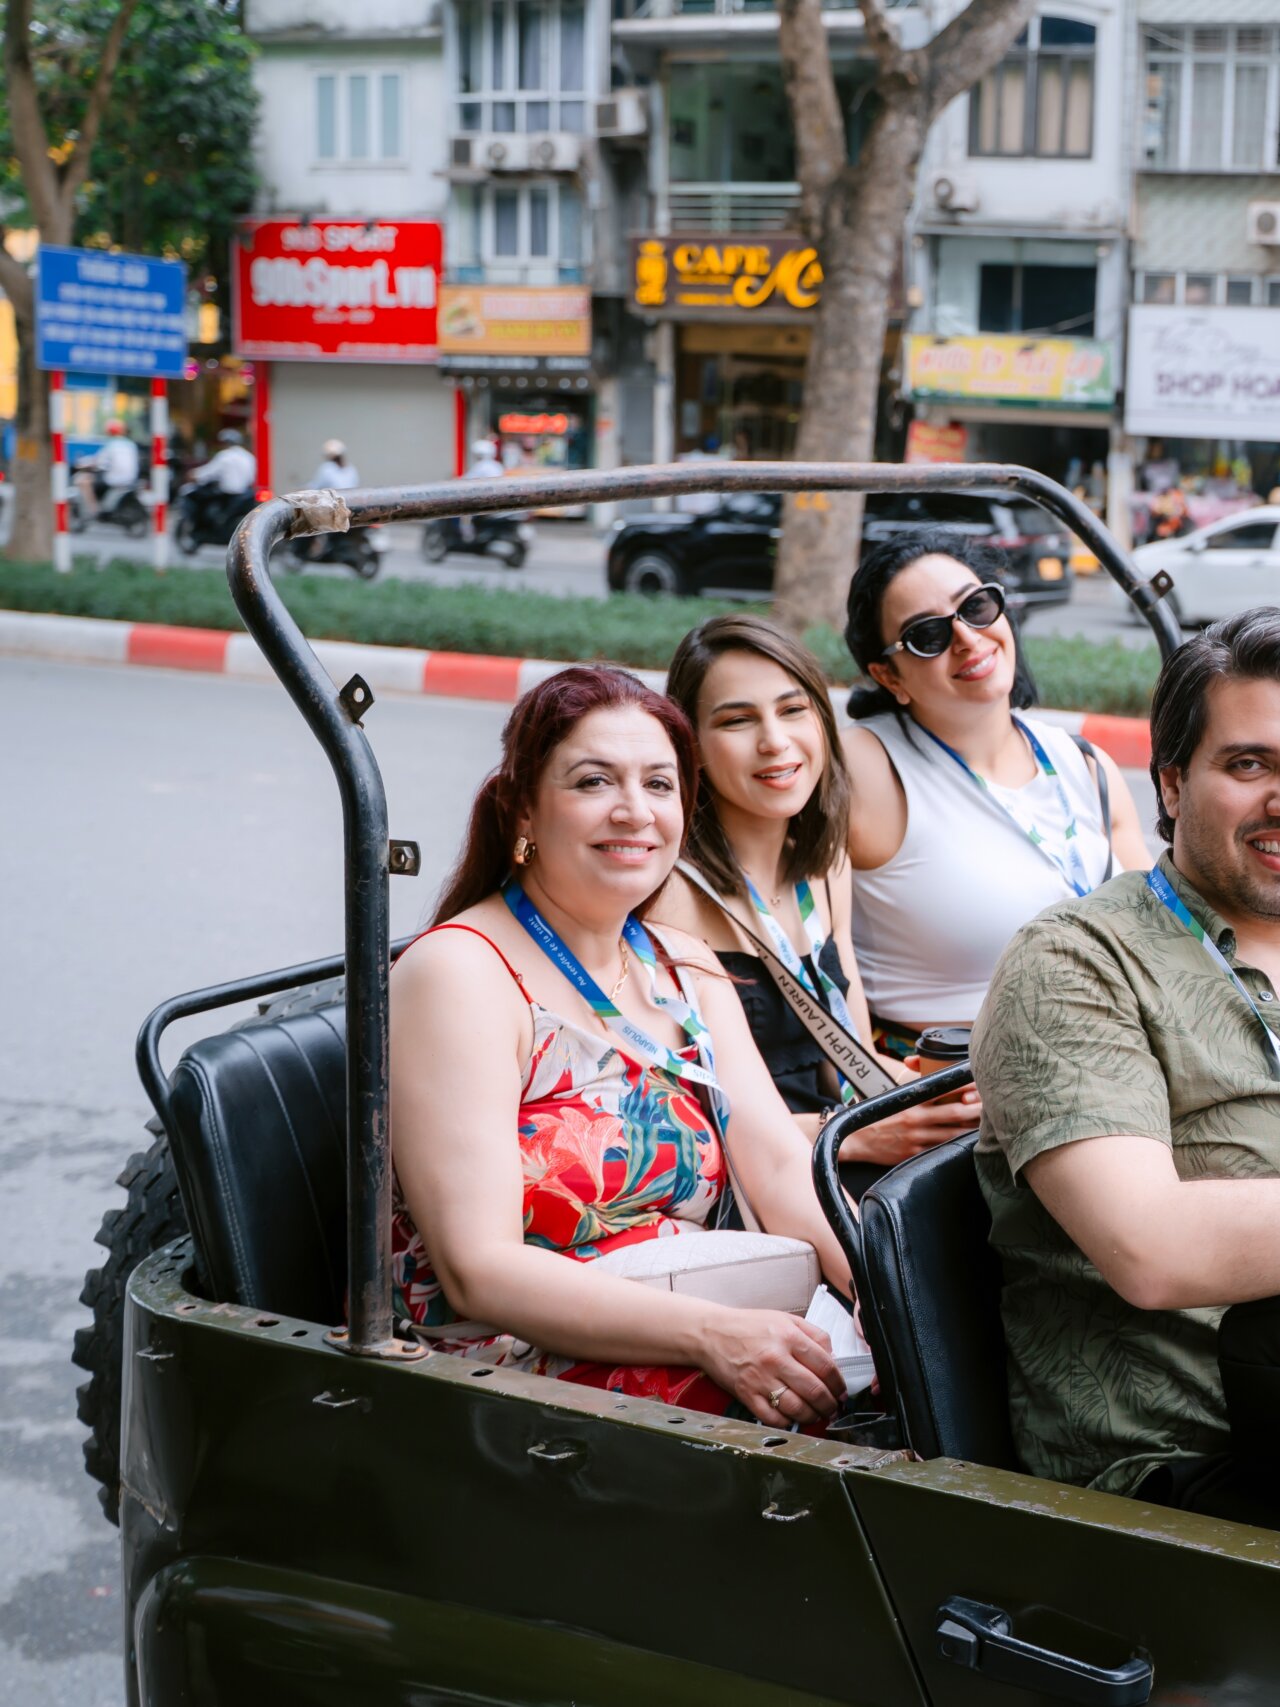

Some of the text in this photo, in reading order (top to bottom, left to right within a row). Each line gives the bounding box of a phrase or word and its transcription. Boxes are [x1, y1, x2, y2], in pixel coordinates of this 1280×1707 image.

[1156, 373, 1224, 397] SHOP
[541, 934, 551, 944] la
[548, 941, 559, 953] de
[555, 950, 578, 978] service
[575, 975, 587, 988] Au
[778, 975, 871, 1079] RALPH LAUREN
[621, 1025, 659, 1055] NEAPOLIS
